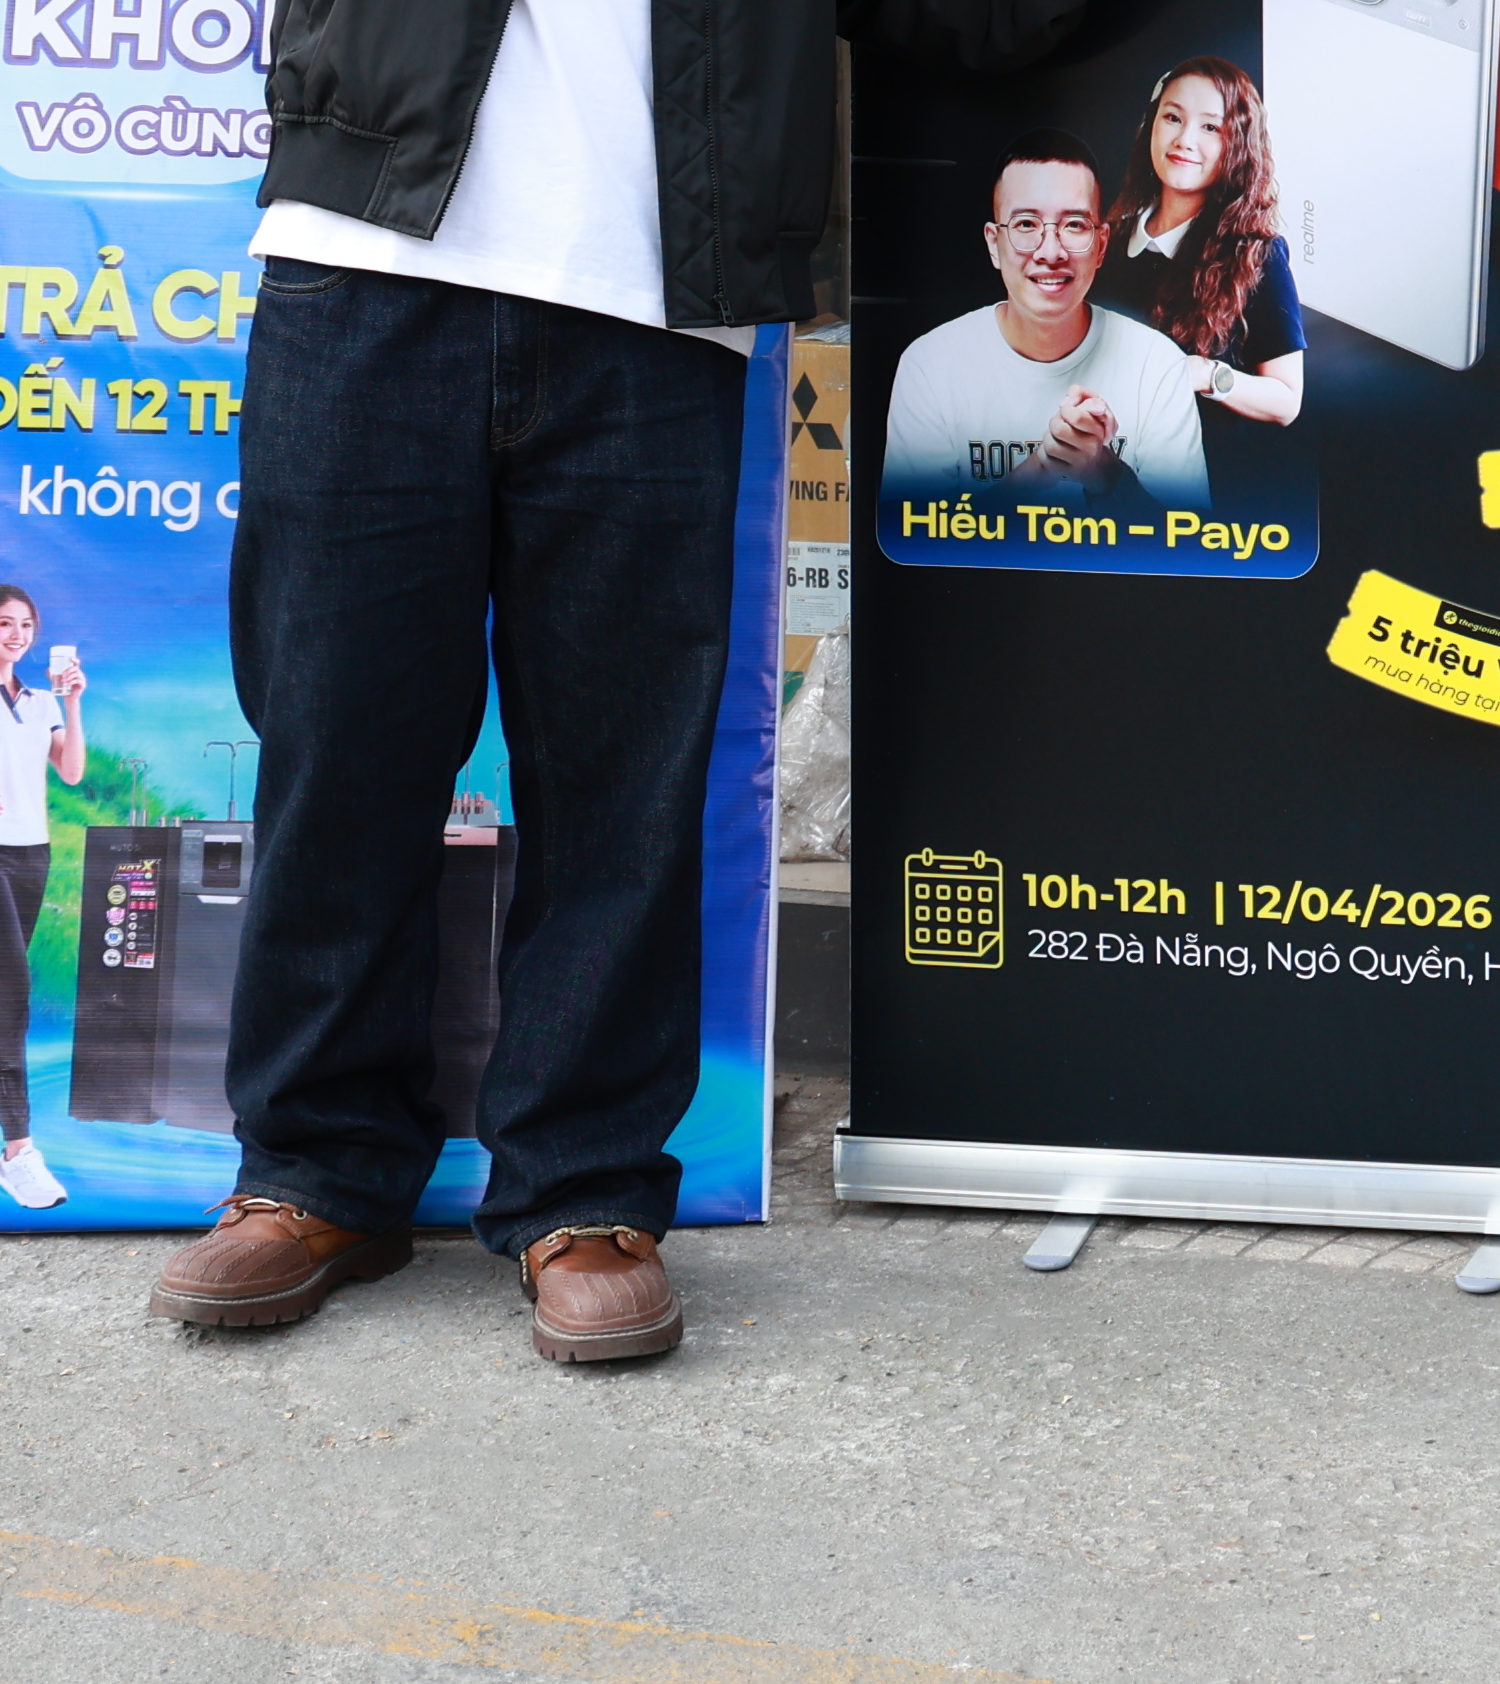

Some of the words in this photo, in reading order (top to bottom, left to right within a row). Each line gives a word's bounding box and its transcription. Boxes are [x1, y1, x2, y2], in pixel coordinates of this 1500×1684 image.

[16, 93, 109, 155] VÔ
[1302, 199, 1316, 265] realme
[106, 377, 169, 435] 12
[20, 464, 203, 534] không
[902, 493, 1005, 540] Hiếu
[1166, 510, 1290, 561] Payo
[1367, 614, 1393, 643] 5
[1400, 630, 1484, 679] triệu
[1364, 653, 1414, 684] mua
[1415, 673, 1469, 706] hàng
[1022, 872, 1186, 916] 10h-12h
[1237, 880, 1493, 930] 12/04/2026
[1027, 929, 1090, 962] 282
[1095, 929, 1145, 964] Đà
[1155, 933, 1258, 977] Nẵng,
[1266, 940, 1341, 980] Ngô
[1348, 942, 1475, 986] Quyền,
